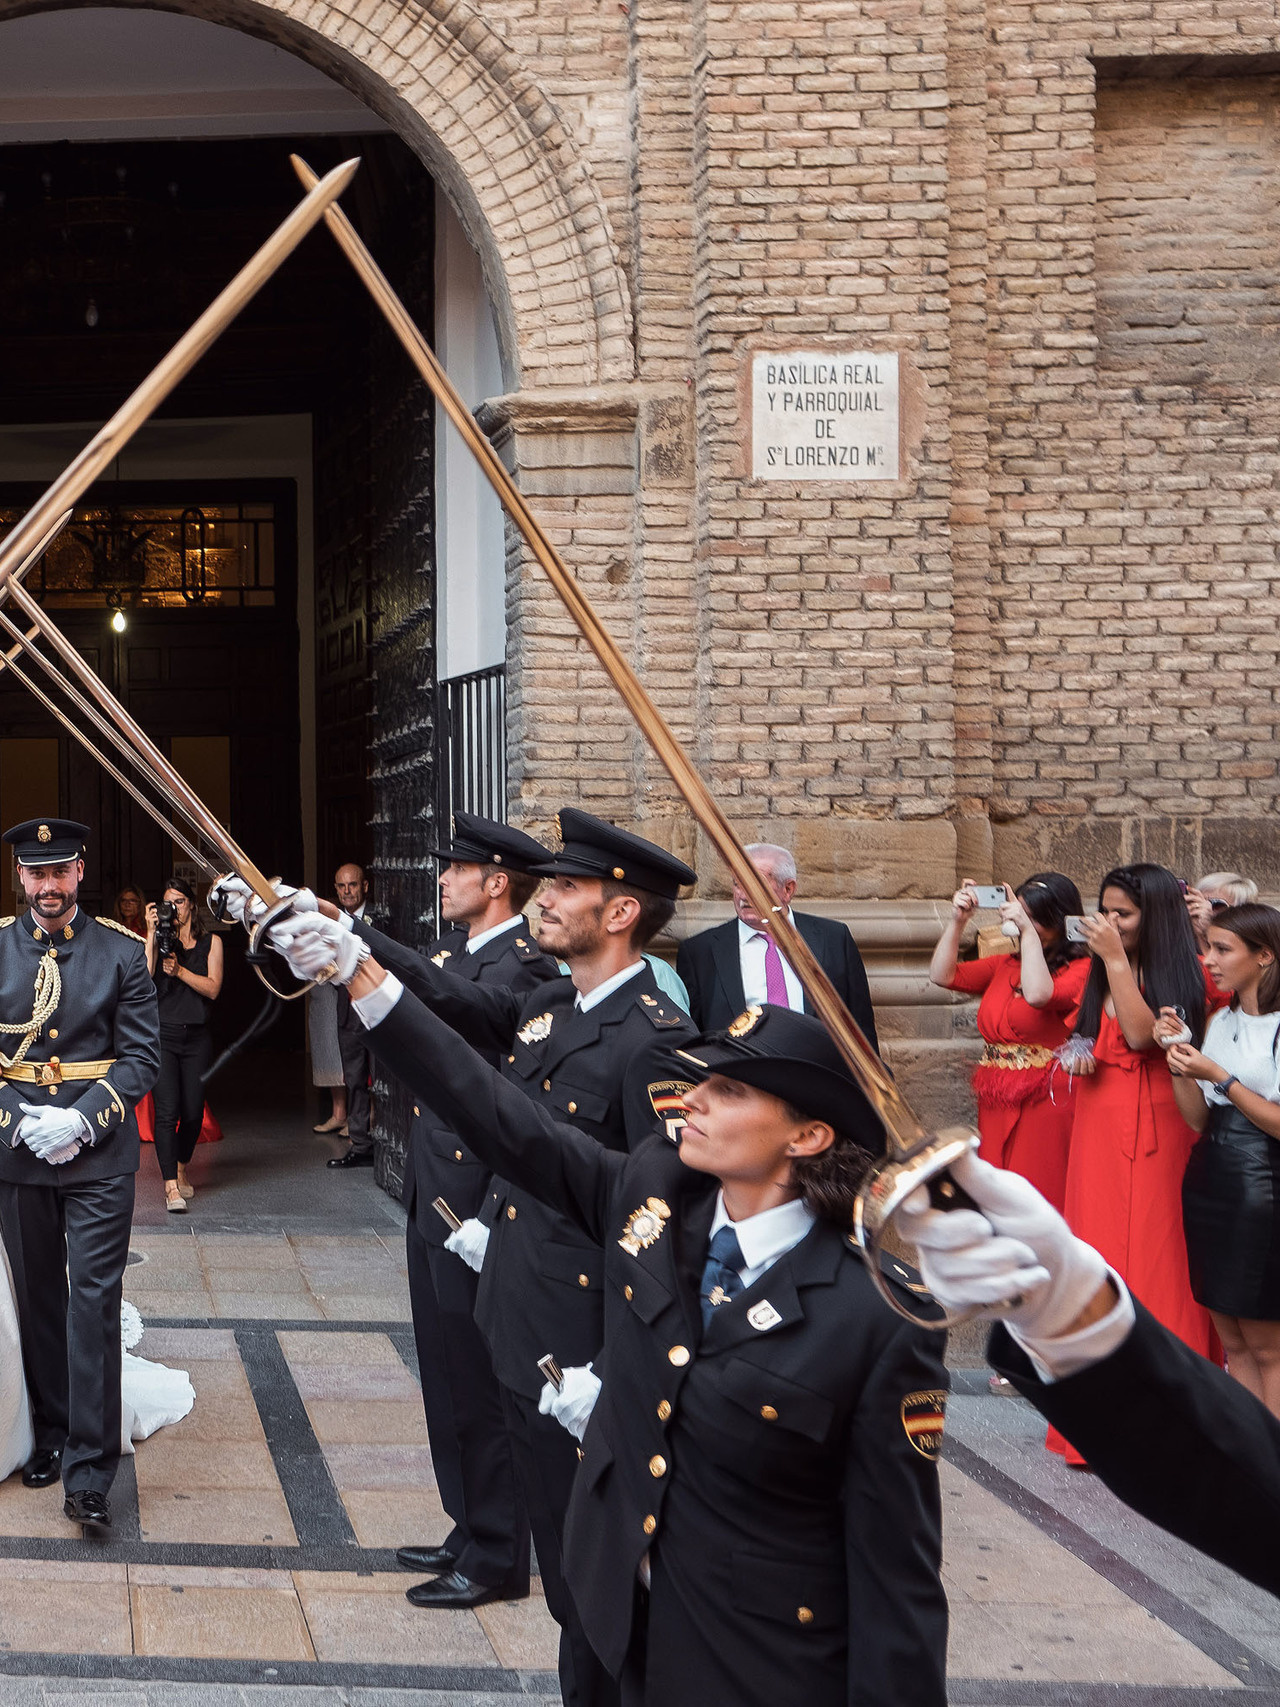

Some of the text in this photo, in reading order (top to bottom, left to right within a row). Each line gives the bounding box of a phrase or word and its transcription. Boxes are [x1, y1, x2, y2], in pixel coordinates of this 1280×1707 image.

[843, 364, 884, 385] REAL
[767, 391, 884, 414] Y PARROQUIAL
[815, 419, 836, 438] DE
